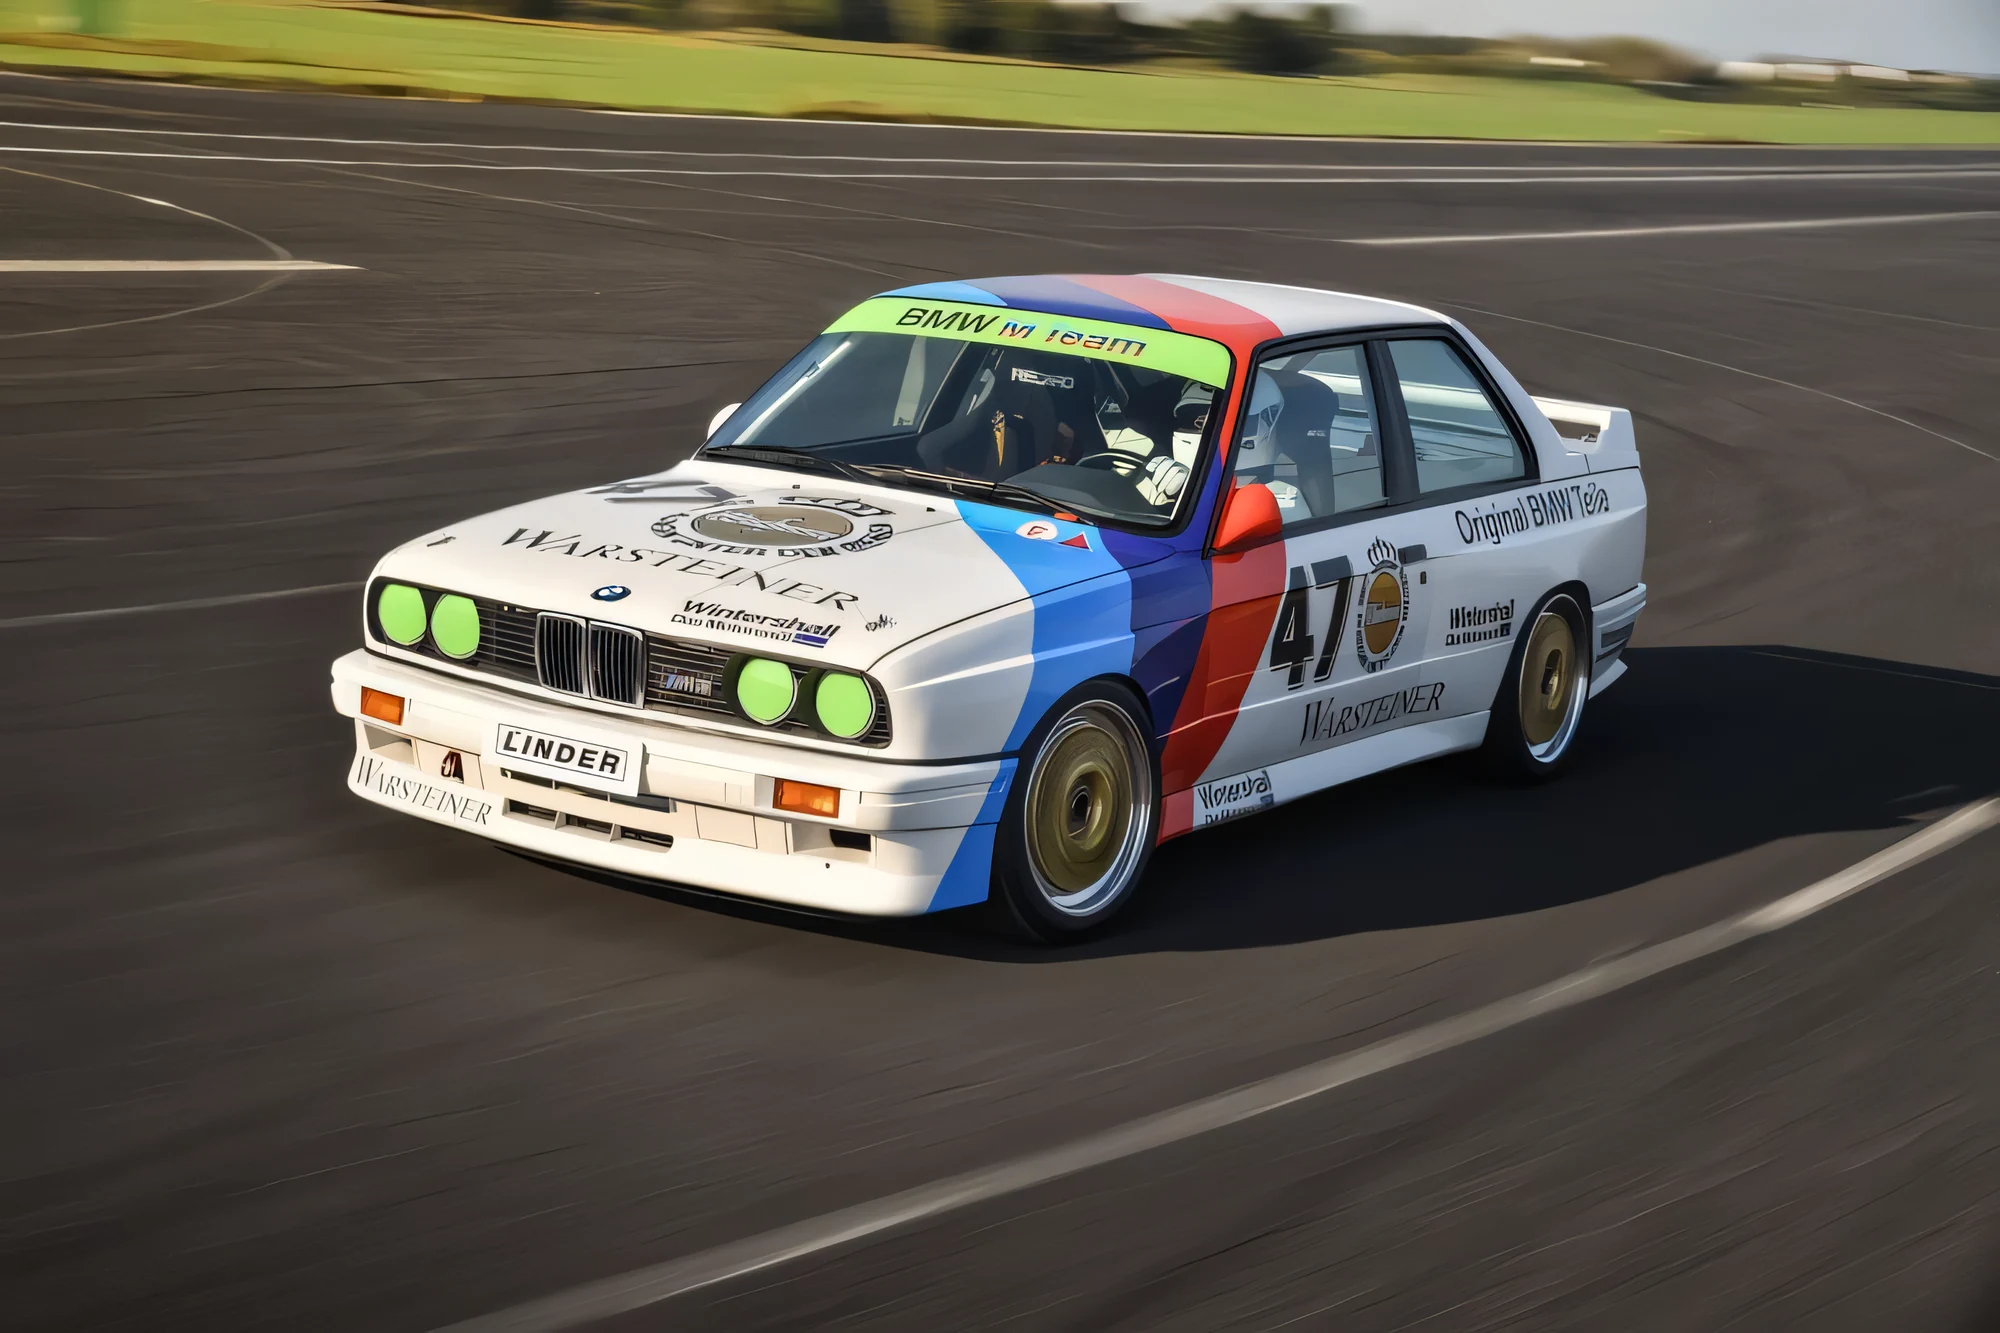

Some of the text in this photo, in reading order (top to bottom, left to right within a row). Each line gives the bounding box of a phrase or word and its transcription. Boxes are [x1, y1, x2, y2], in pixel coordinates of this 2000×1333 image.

[896, 307, 1000, 333] BMW
[998, 319, 1037, 339] M
[1526, 486, 1574, 529] BMW
[501, 527, 861, 612] WARSTEINER
[1269, 553, 1354, 692] 47
[1299, 681, 1447, 747] WARSTEINER
[502, 729, 622, 776] LINDER
[356, 755, 494, 826] WARSTEINER
